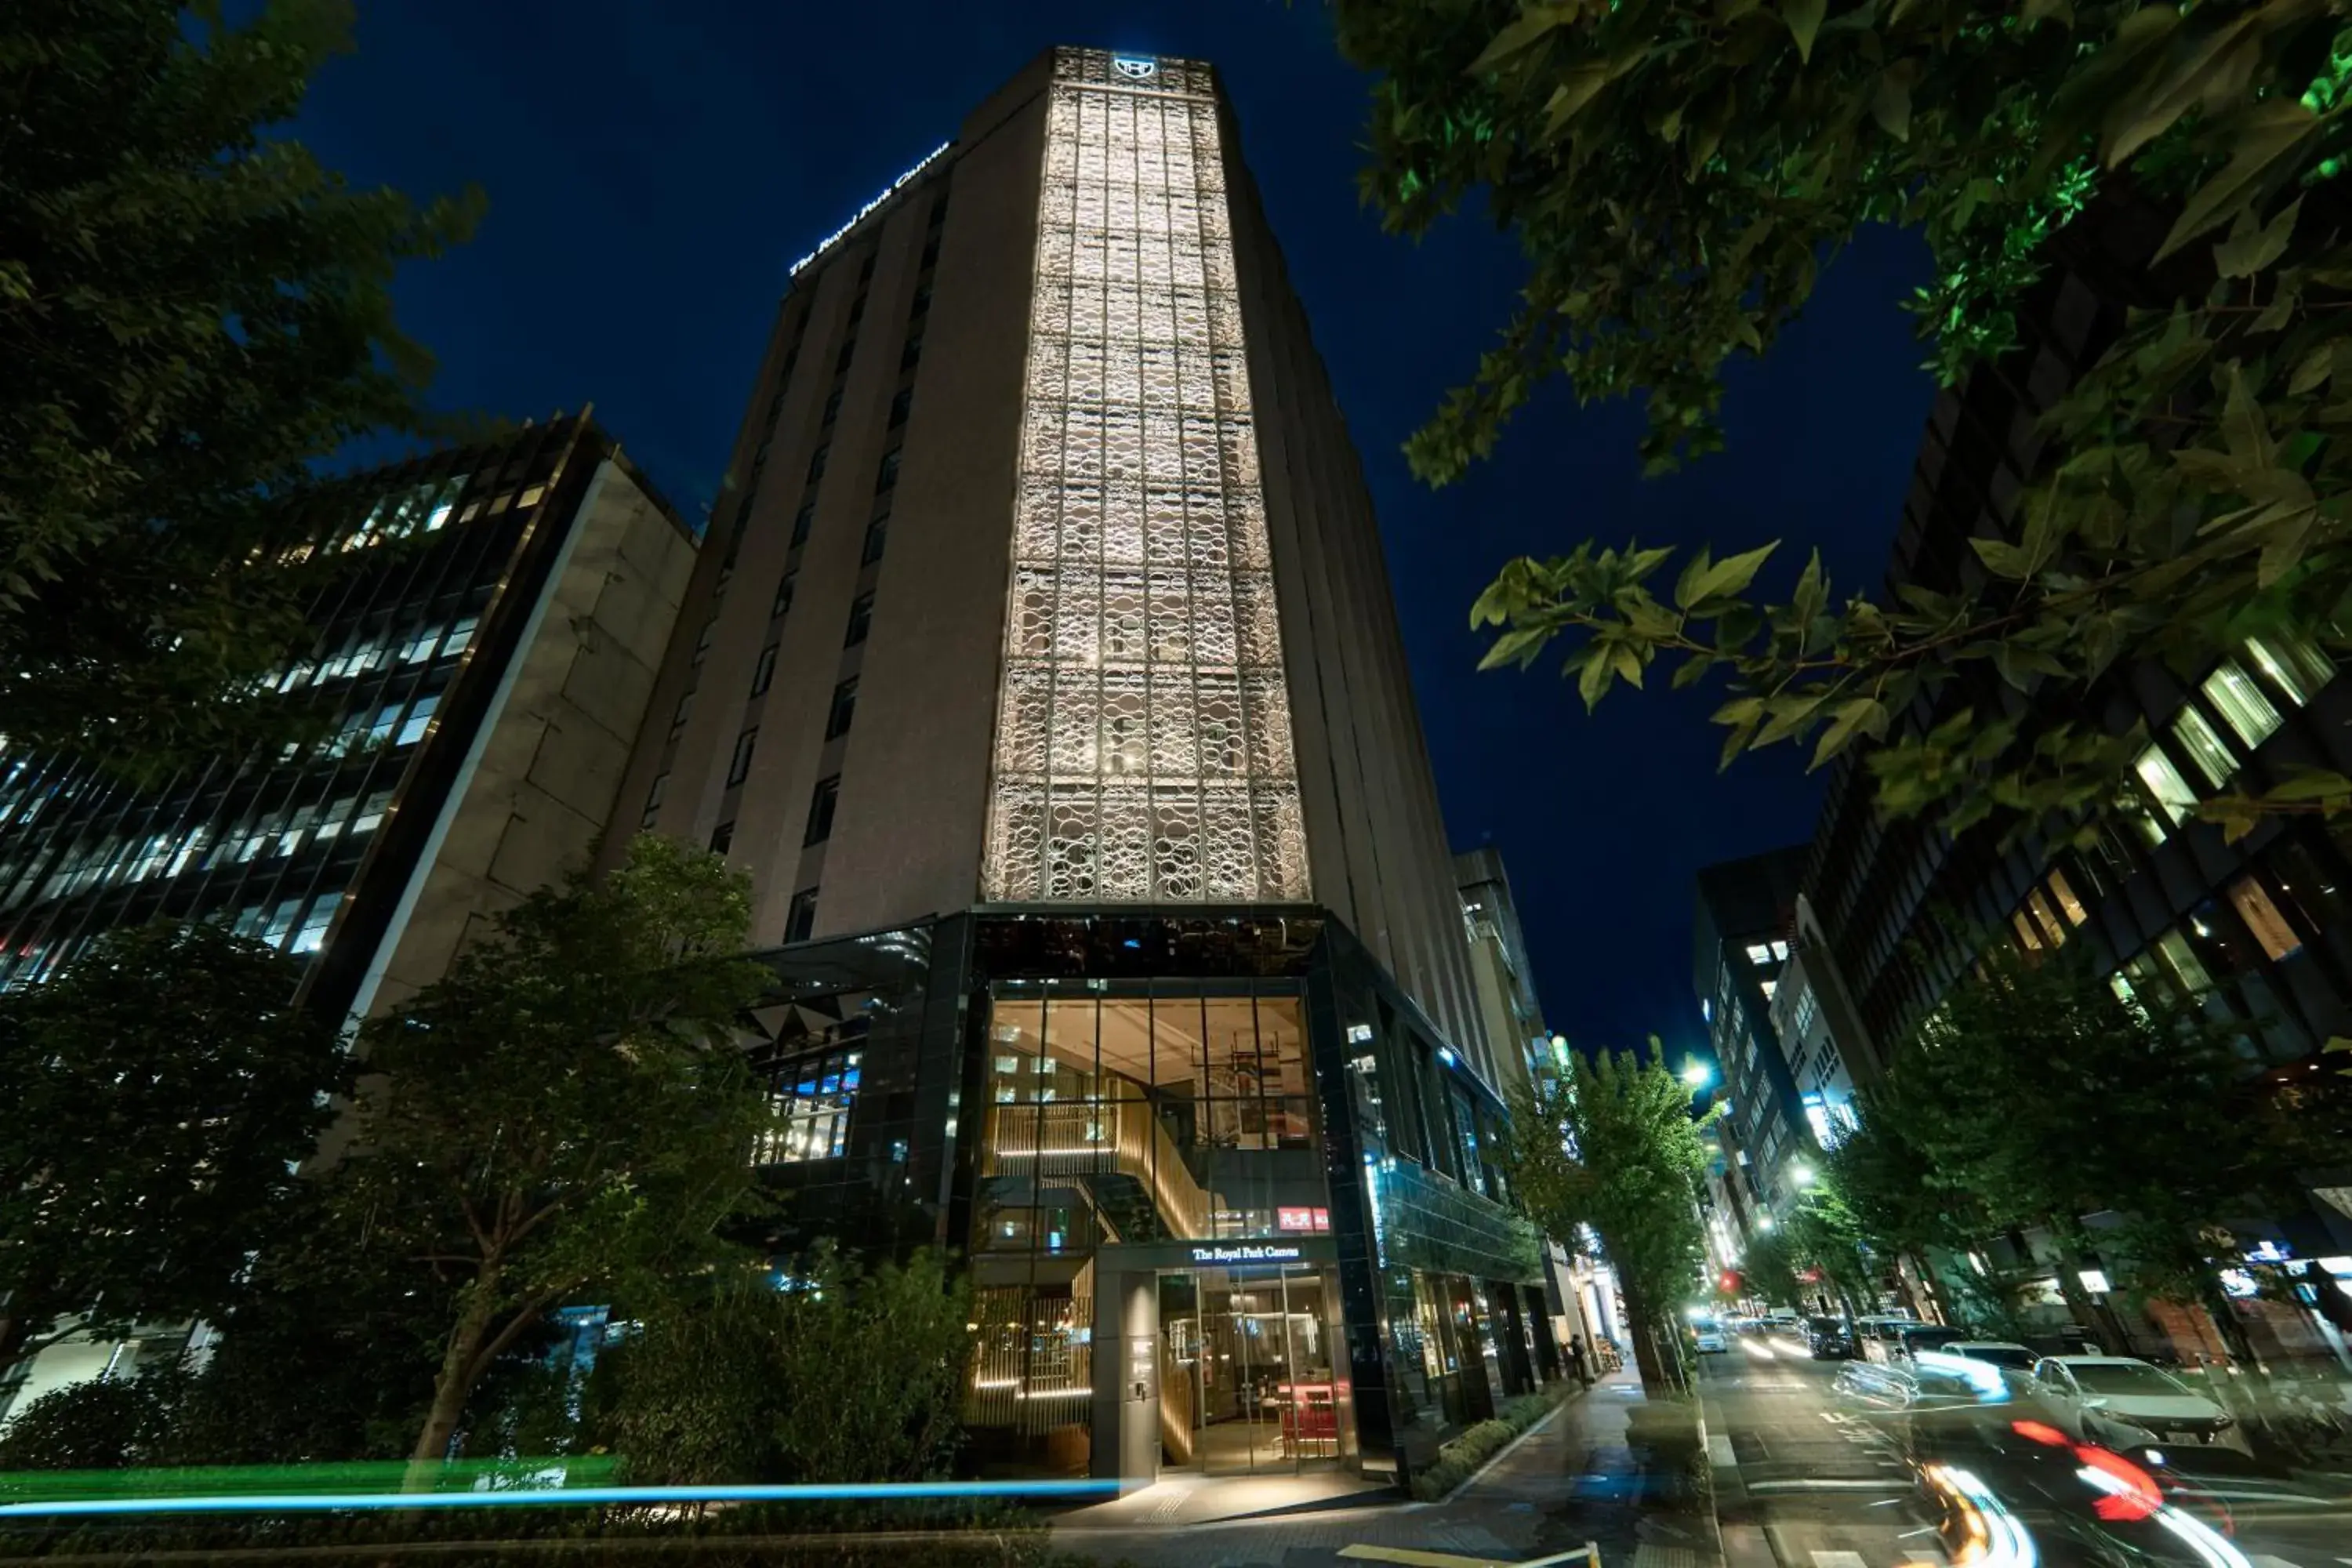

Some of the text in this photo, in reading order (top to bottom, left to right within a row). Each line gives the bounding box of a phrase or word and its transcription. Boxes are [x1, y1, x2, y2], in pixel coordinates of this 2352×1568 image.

[1192, 1248, 1213, 1260] The
[1214, 1247, 1241, 1261] Royal
[1243, 1247, 1264, 1258] Park
